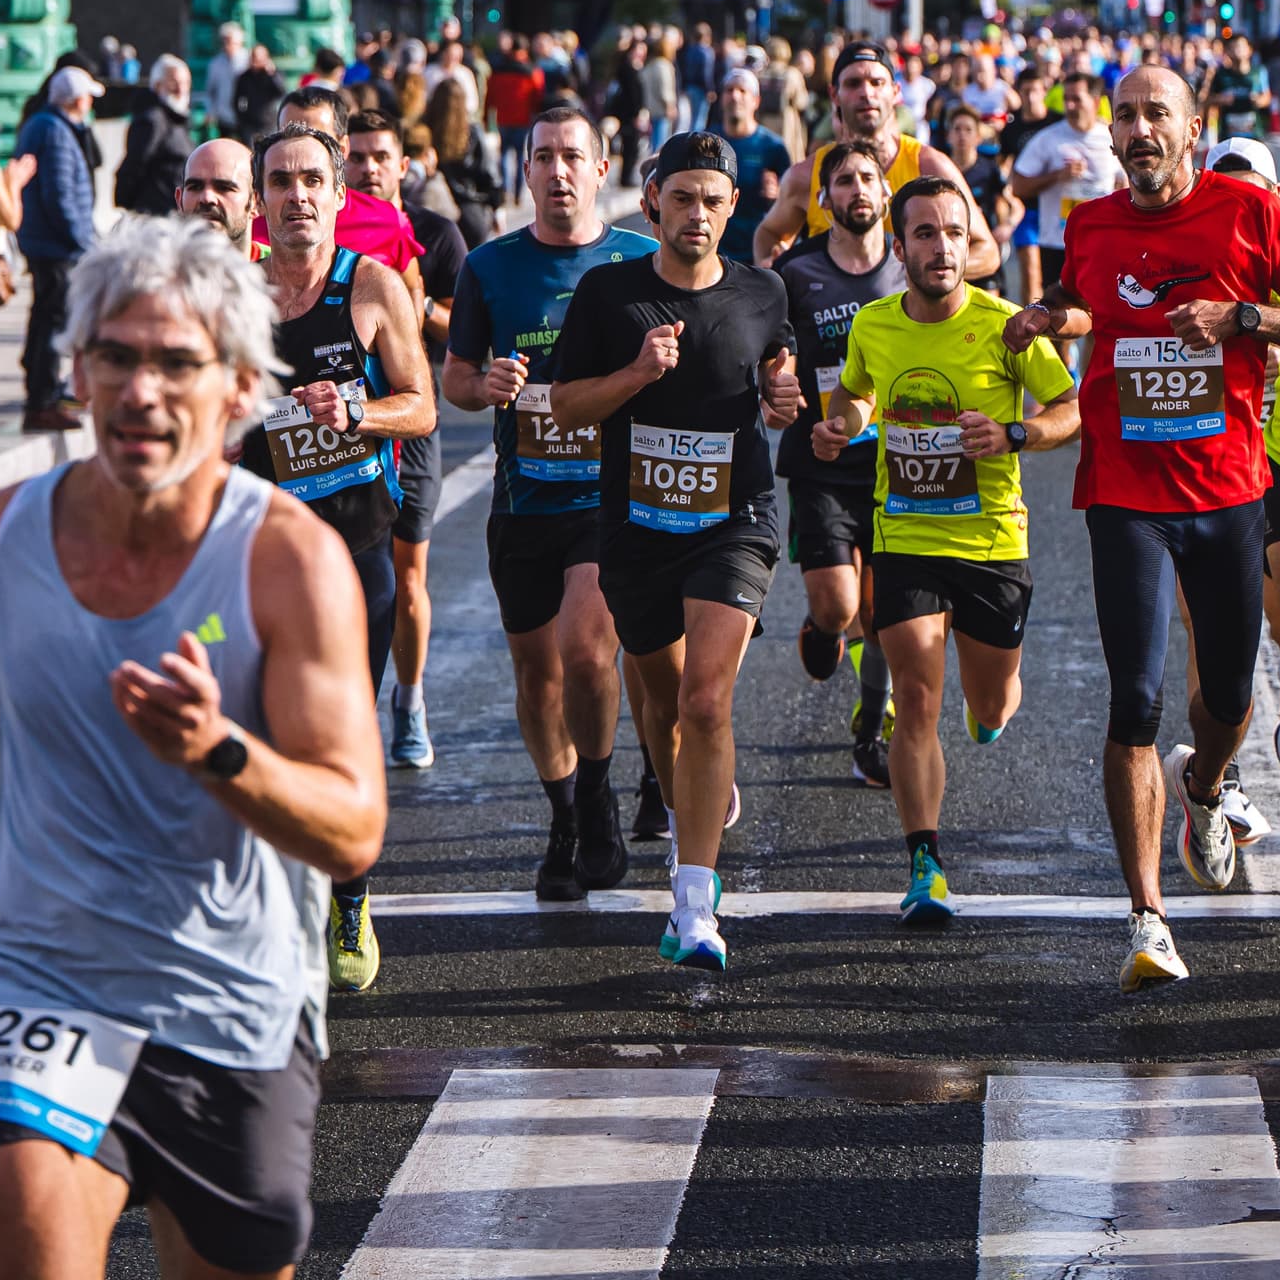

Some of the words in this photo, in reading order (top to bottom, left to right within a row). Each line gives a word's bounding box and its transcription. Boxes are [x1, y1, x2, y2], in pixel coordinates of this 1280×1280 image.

[814, 301, 860, 325] SALTO
[1117, 348, 1141, 357] salto
[1130, 371, 1208, 398] 1292
[1152, 401, 1190, 411] ANDER
[1125, 423, 1145, 432] DKV
[634, 435, 656, 447] salto
[546, 444, 581, 454] JULEN
[290, 457, 317, 472] LUIS
[320, 443, 367, 466] CARLOS
[894, 457, 960, 482] 1077
[641, 460, 718, 493] 1065
[912, 483, 945, 494] JOKIN
[663, 493, 691, 505] XABI
[633, 508, 651, 520] DKV
[658, 511, 677, 519] SALTO
